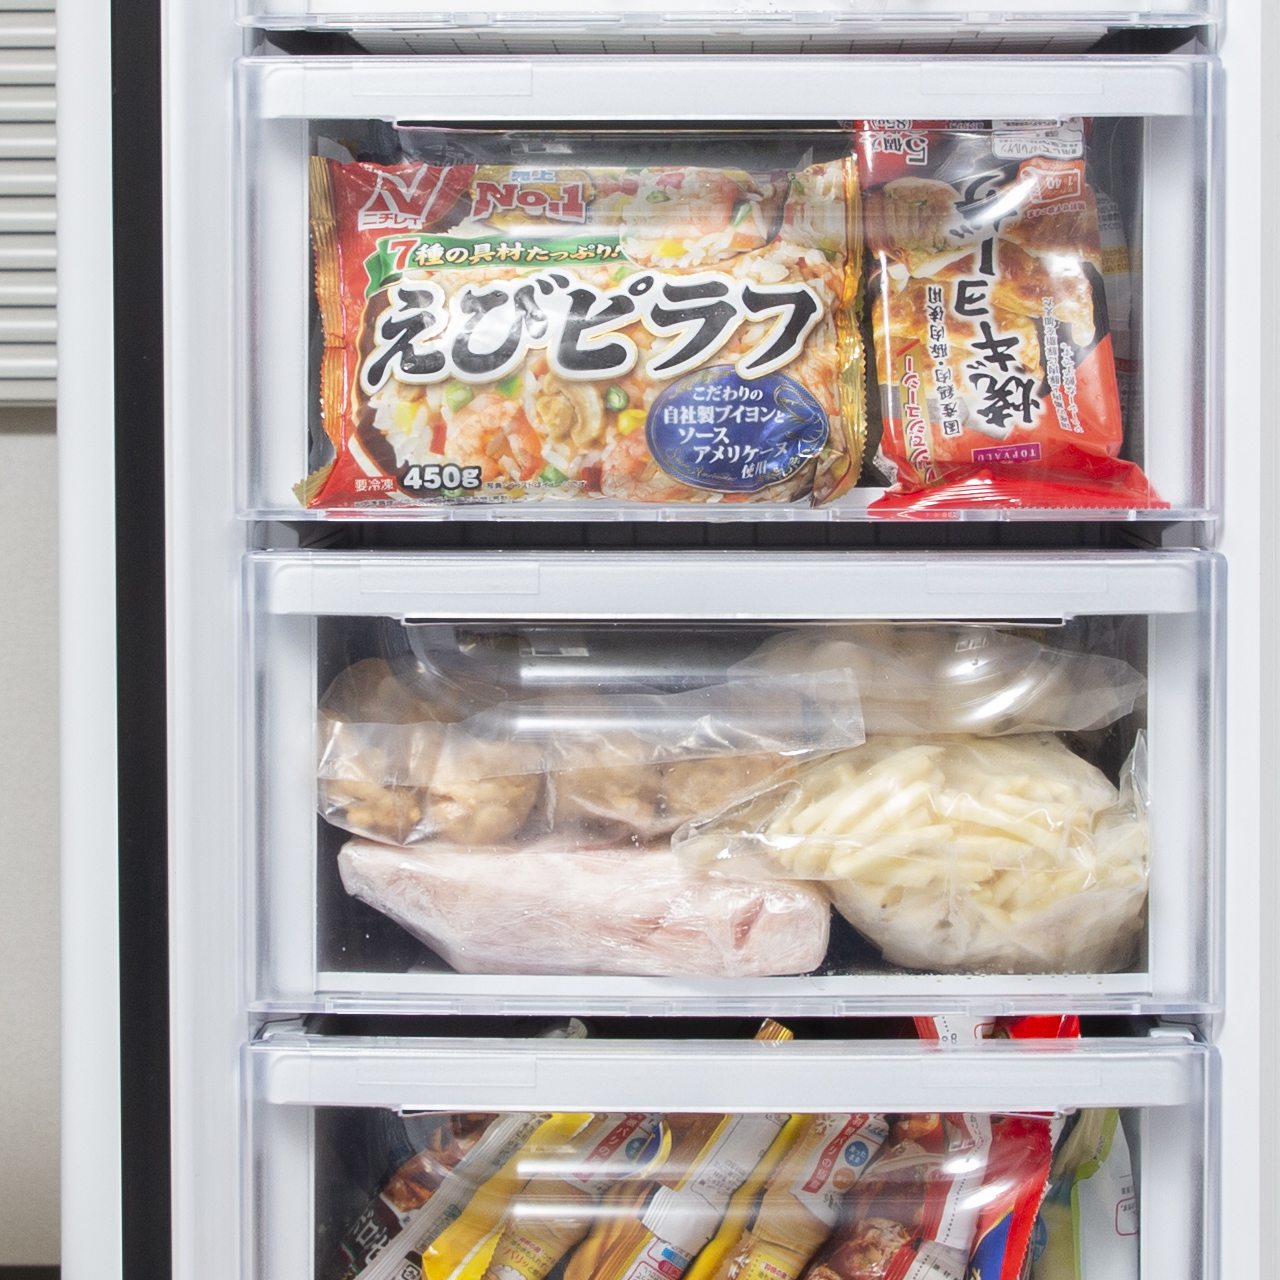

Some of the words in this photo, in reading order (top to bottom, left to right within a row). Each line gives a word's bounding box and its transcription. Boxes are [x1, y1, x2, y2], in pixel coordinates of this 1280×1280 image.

[473, 182, 586, 222] No.1
[360, 211, 424, 230] ニチレイ
[952, 174, 1043, 430] 焼ギョーザ
[360, 272, 823, 396] えびピラフ
[923, 286, 963, 436] 国産鶏肉・豚肉使用
[693, 385, 763, 401] こだわりの
[664, 406, 787, 425] 自社製ブイヨンと
[678, 427, 730, 444] ソース
[693, 441, 788, 464] アメリケーヌ
[403, 464, 481, 491] 450g
[741, 460, 767, 480] 使用
[354, 478, 394, 492] 要冷凍
